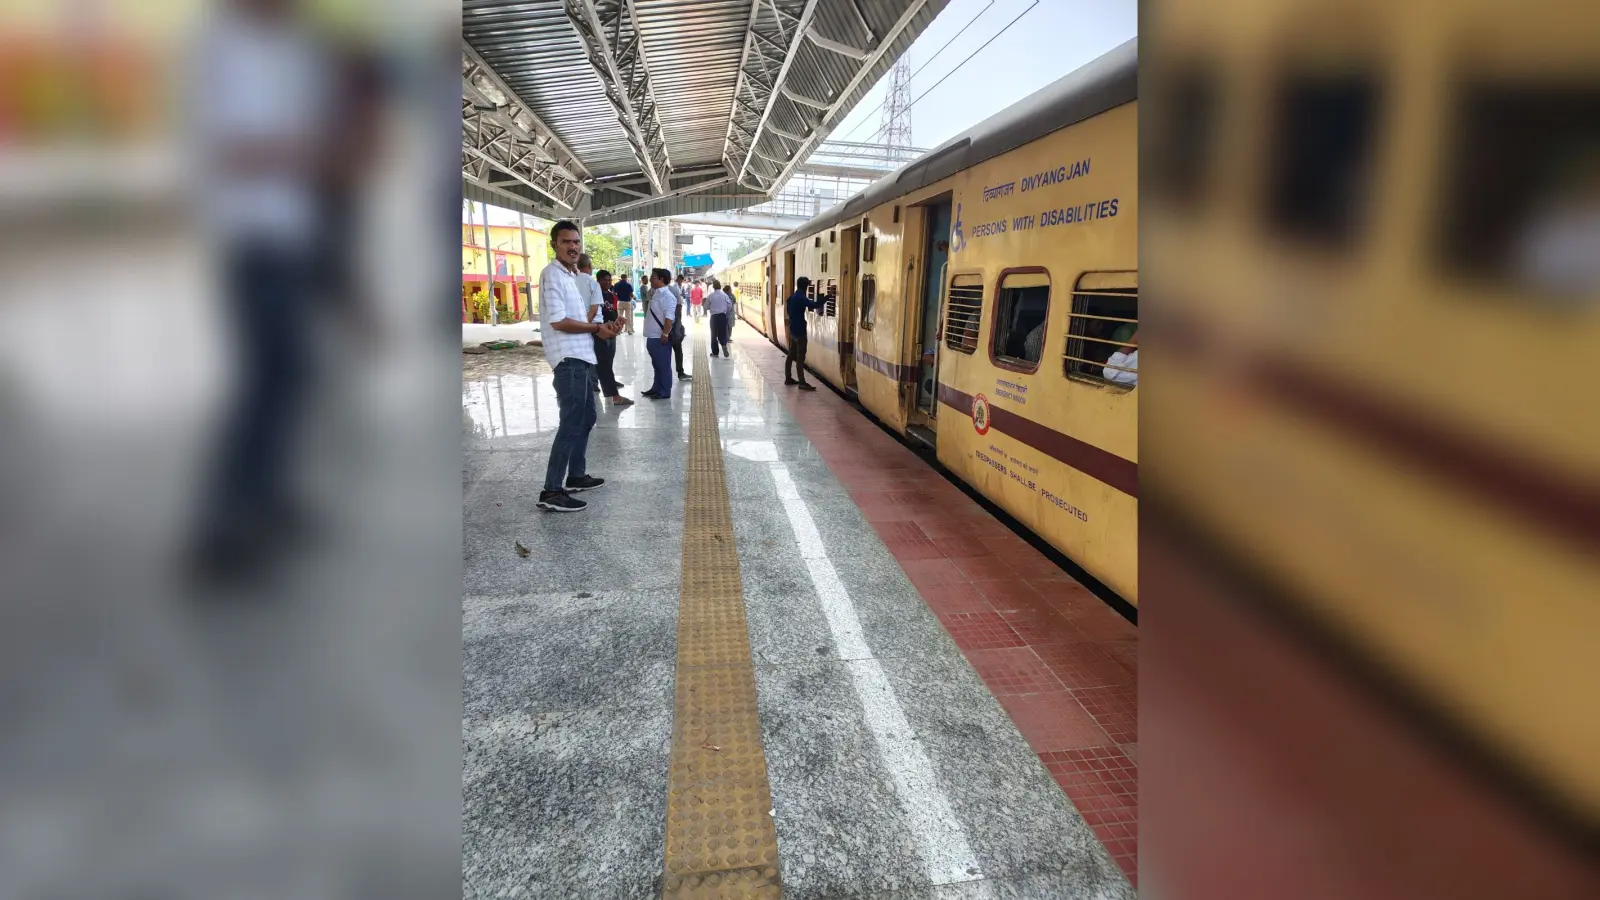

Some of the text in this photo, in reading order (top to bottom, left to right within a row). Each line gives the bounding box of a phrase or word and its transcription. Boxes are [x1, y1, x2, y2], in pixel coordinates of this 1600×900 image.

[972, 198, 1119, 239] PERSONS WITH DISABILITIES
[975, 450, 1007, 475] TRESPASSERS
[1010, 470, 1027, 488] SHALL
[1027, 480, 1037, 492] BE
[1041, 488, 1088, 523] PROSECUTED
